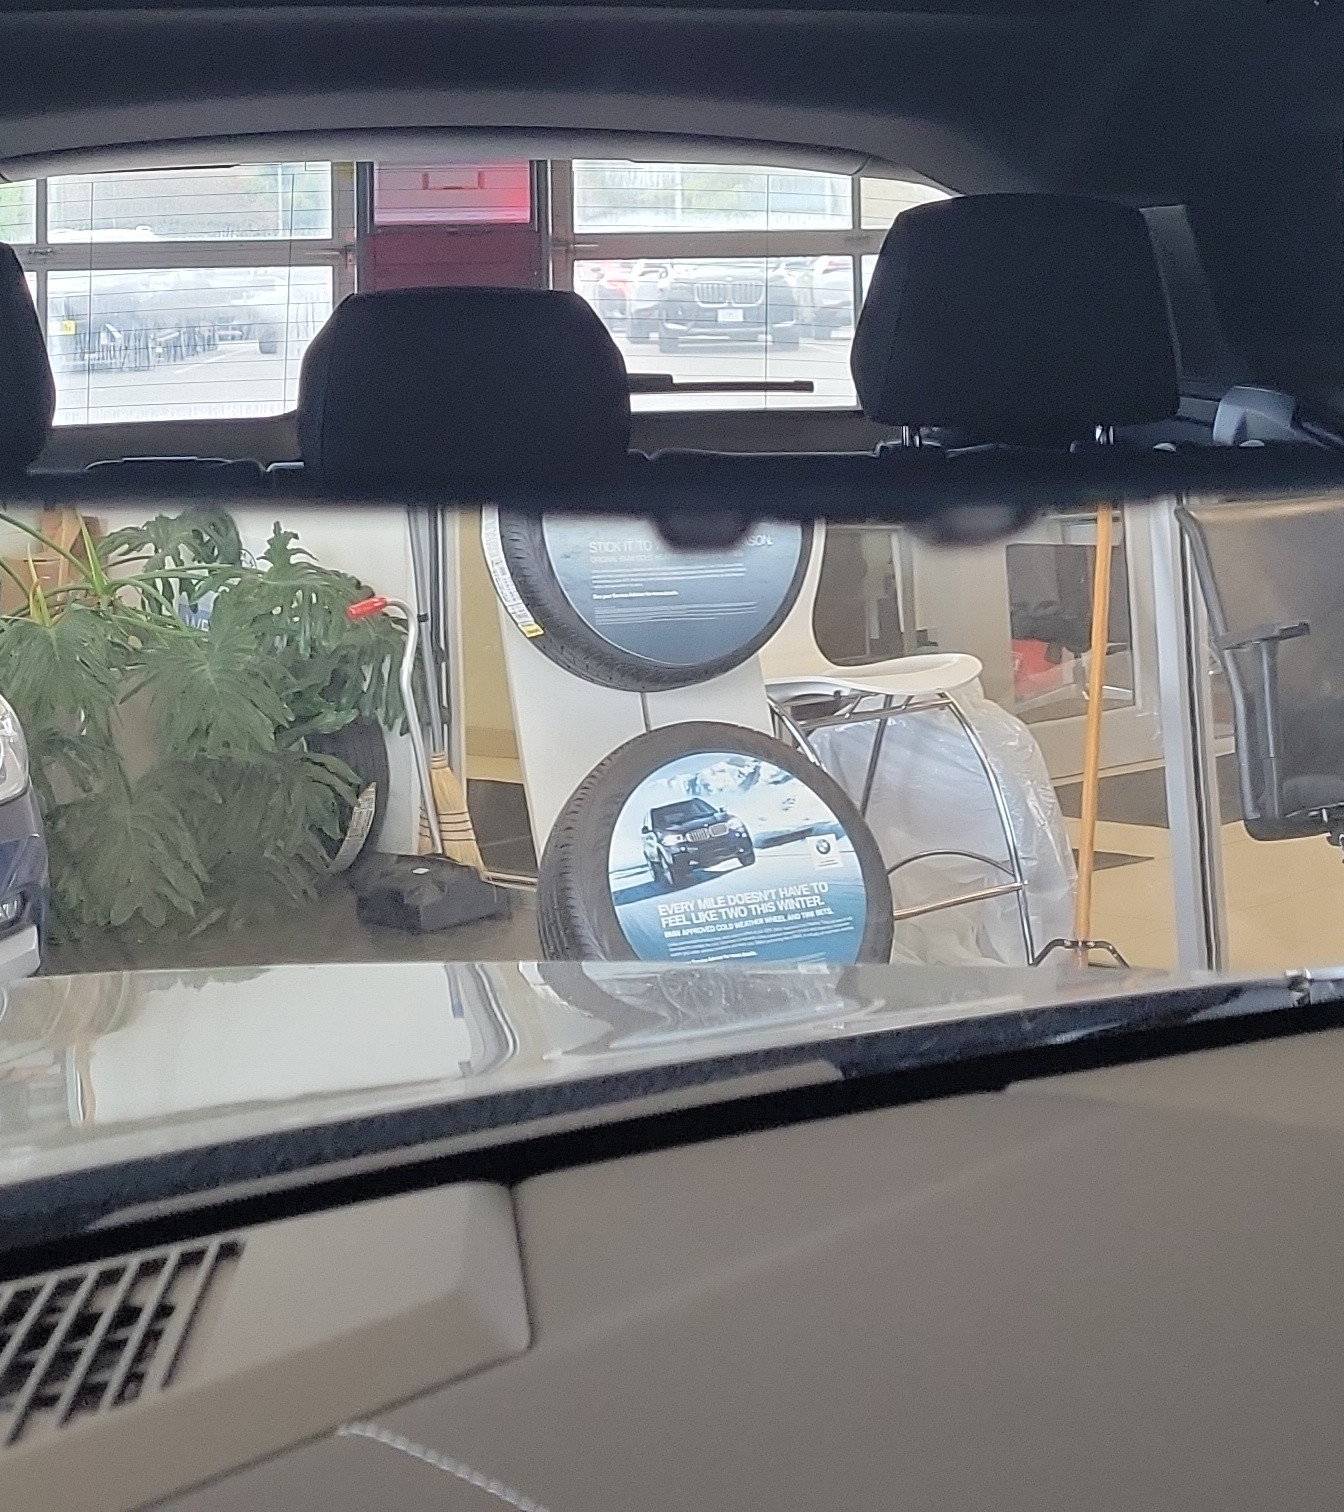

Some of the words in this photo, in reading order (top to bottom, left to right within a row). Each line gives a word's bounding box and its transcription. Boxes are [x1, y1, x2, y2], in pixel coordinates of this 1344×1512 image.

[658, 899, 696, 916] EVERY
[697, 896, 726, 910] MILE
[727, 888, 777, 907] DOESN'T
[778, 884, 810, 899] HAVE
[812, 881, 829, 893] TO
[660, 914, 691, 929] FEEL
[692, 910, 719, 924] LIKE
[719, 906, 748, 920] TWO
[749, 901, 776, 916] THIS
[776, 895, 825, 911] WINTER.
[716, 922, 734, 932] COLD
